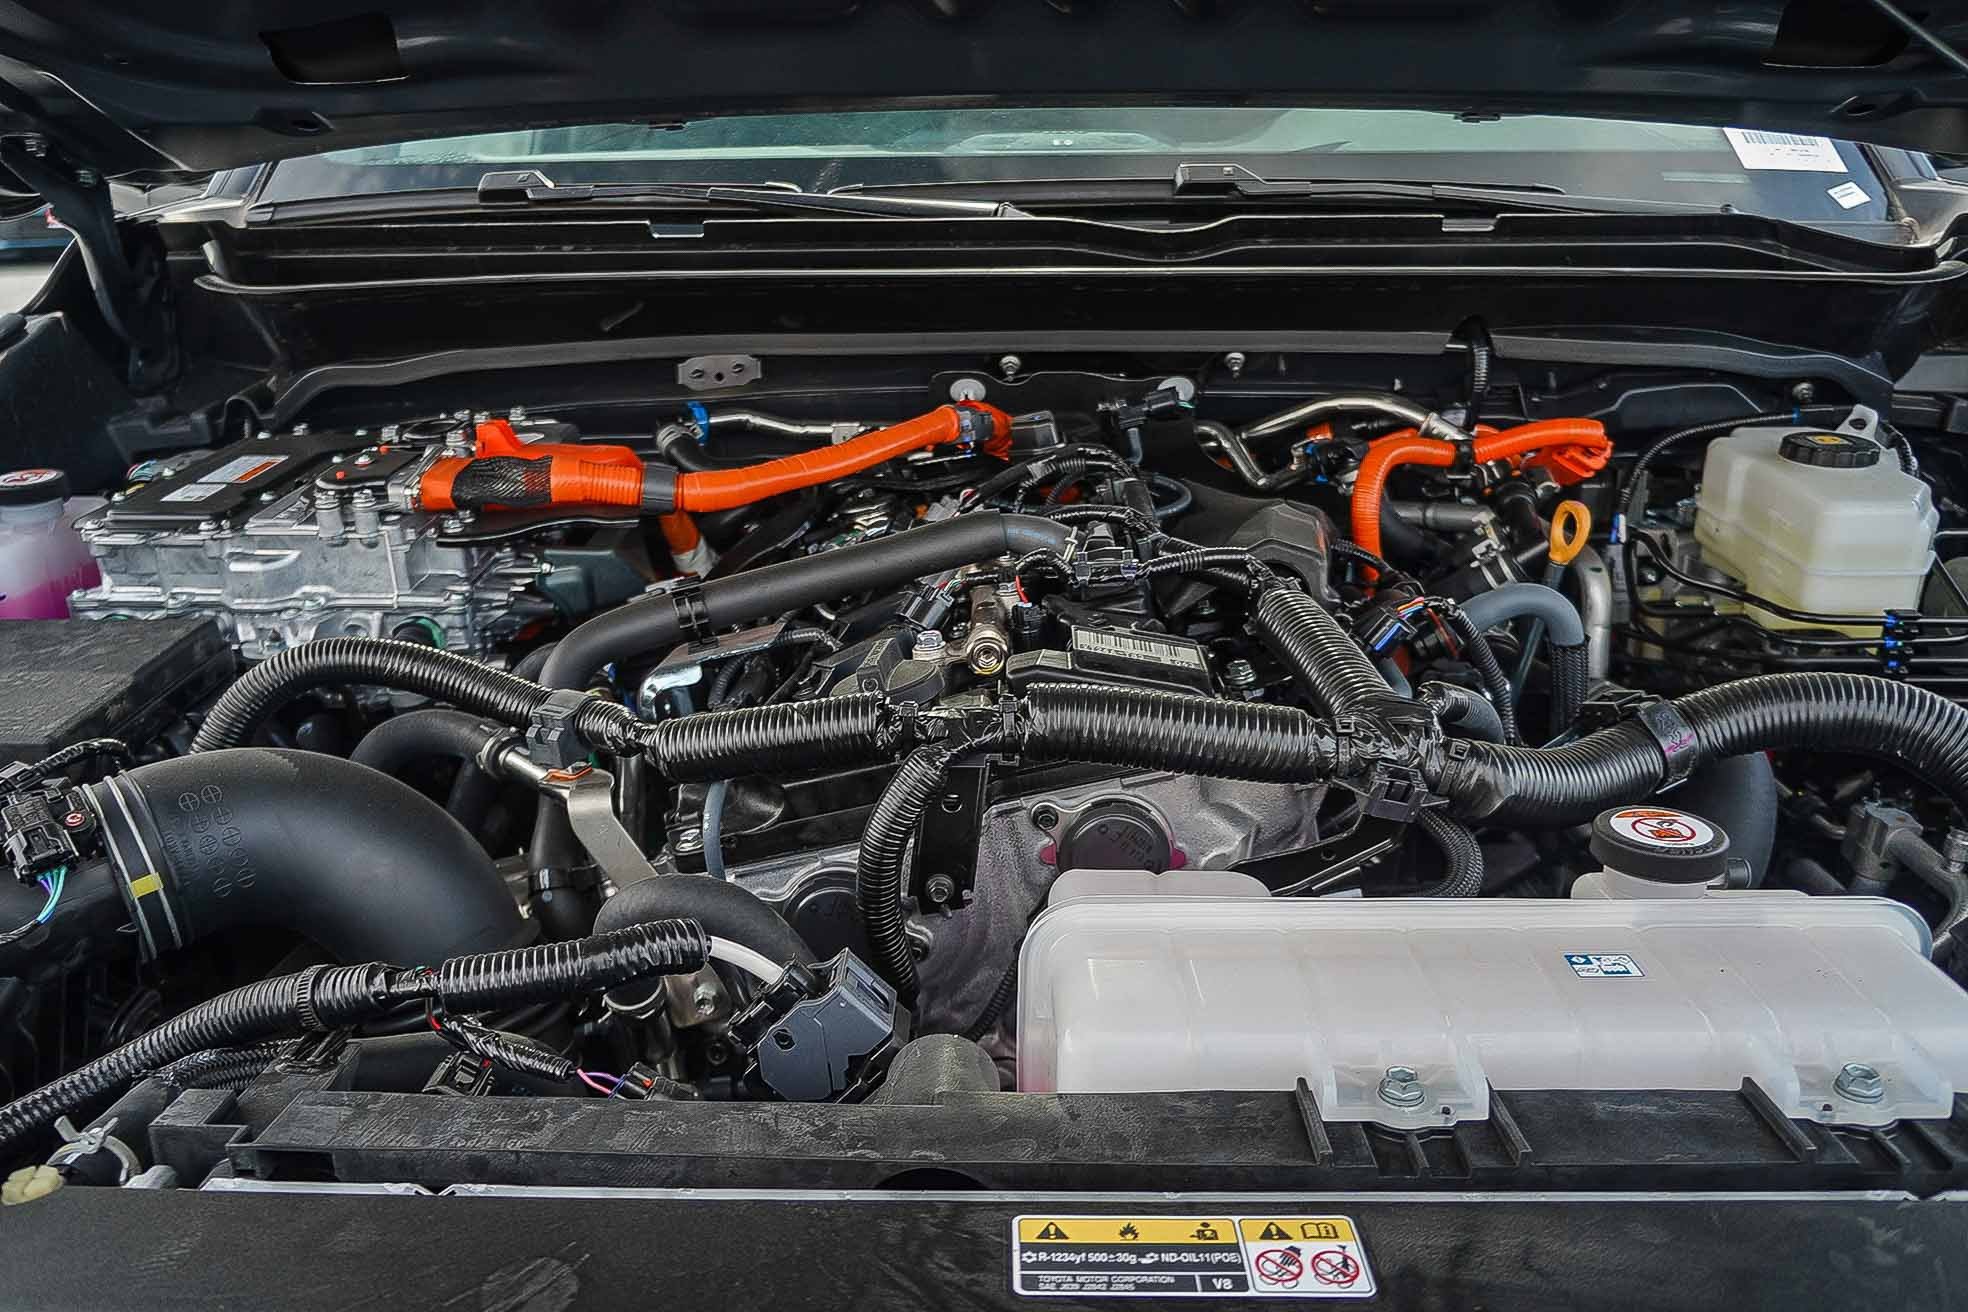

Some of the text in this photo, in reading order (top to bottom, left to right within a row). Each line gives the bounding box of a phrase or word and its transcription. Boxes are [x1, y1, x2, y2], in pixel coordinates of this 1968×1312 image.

[1038, 1275, 1175, 1284] TOYOTA MOTOR CORPORATION
